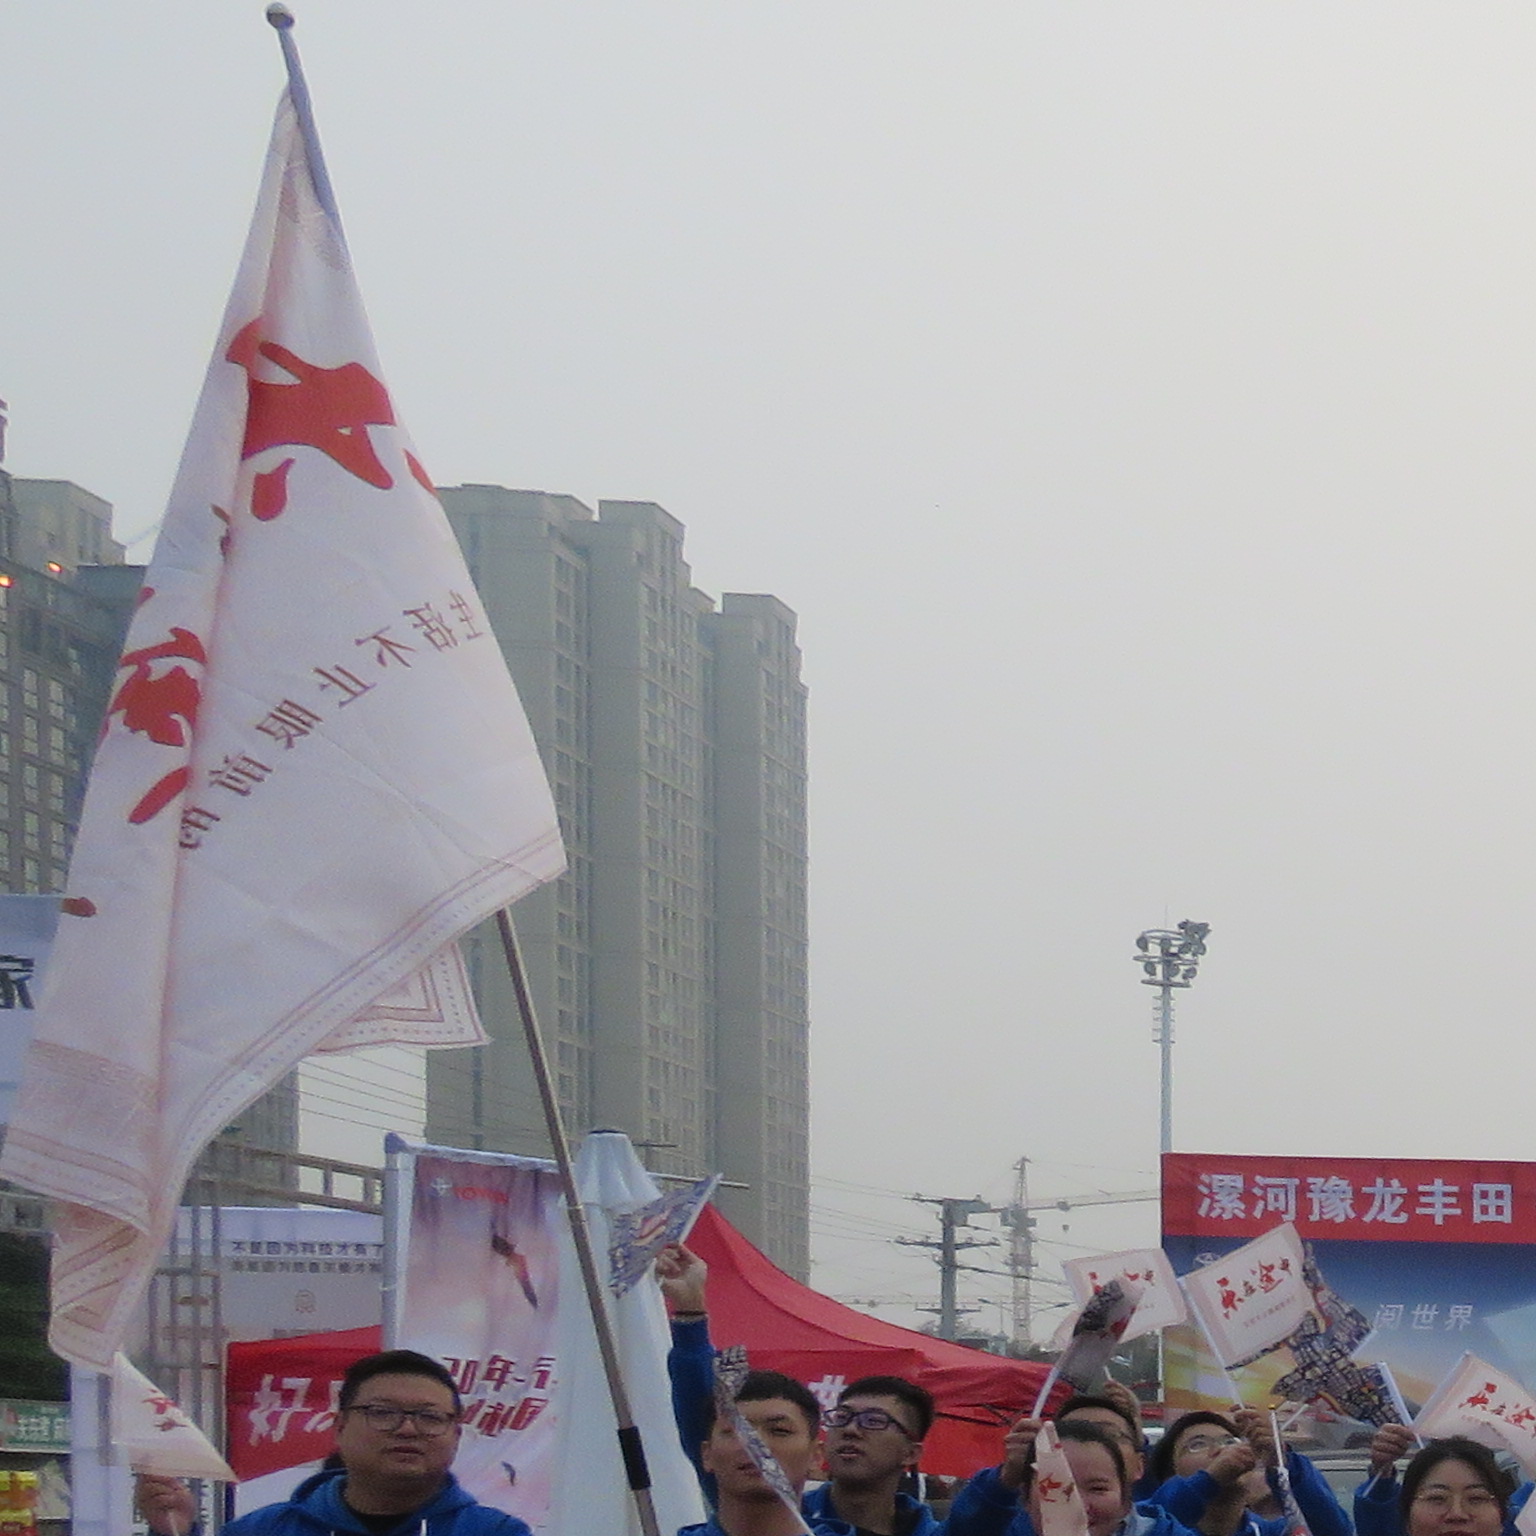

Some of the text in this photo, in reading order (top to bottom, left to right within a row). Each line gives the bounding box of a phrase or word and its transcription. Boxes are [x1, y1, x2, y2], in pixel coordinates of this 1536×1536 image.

[1197, 1173, 1514, 1225] 漯河豫龙丰田
